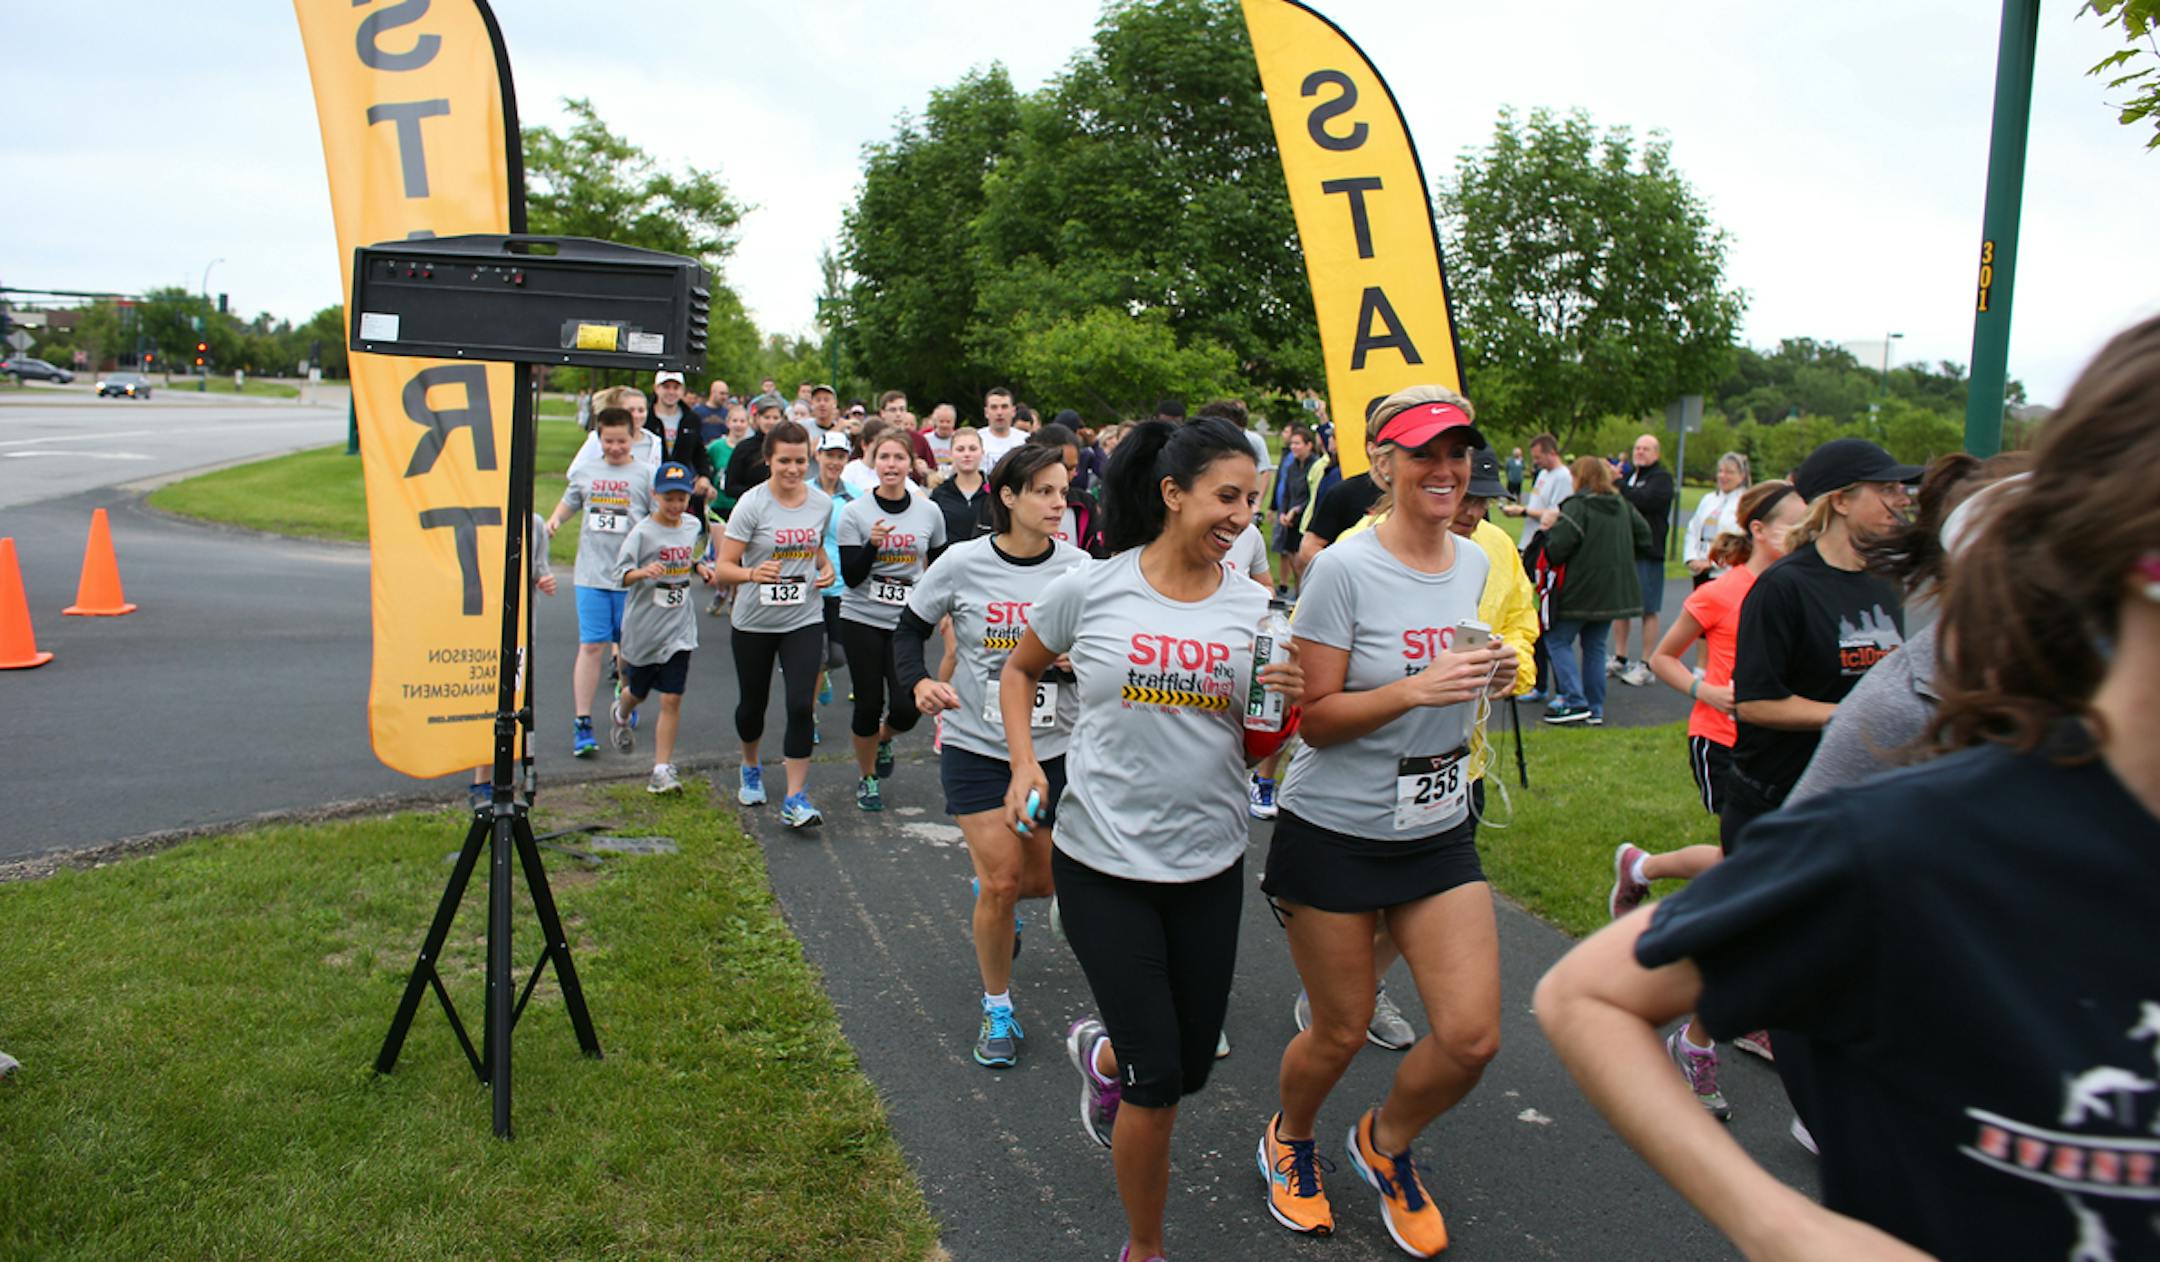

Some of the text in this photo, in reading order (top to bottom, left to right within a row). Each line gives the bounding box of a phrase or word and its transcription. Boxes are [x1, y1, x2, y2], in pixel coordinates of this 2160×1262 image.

[1978, 240, 1994, 312] 301
[592, 480, 629, 493] STOP
[598, 516, 616, 529] 54
[775, 528, 816, 545] STOP
[659, 547, 692, 561] STOP
[771, 586, 799, 601] 132
[878, 584, 905, 601] 133
[1128, 633, 1230, 673] STOP
[1213, 662, 1235, 679] the
[1414, 763, 1459, 805] 258
